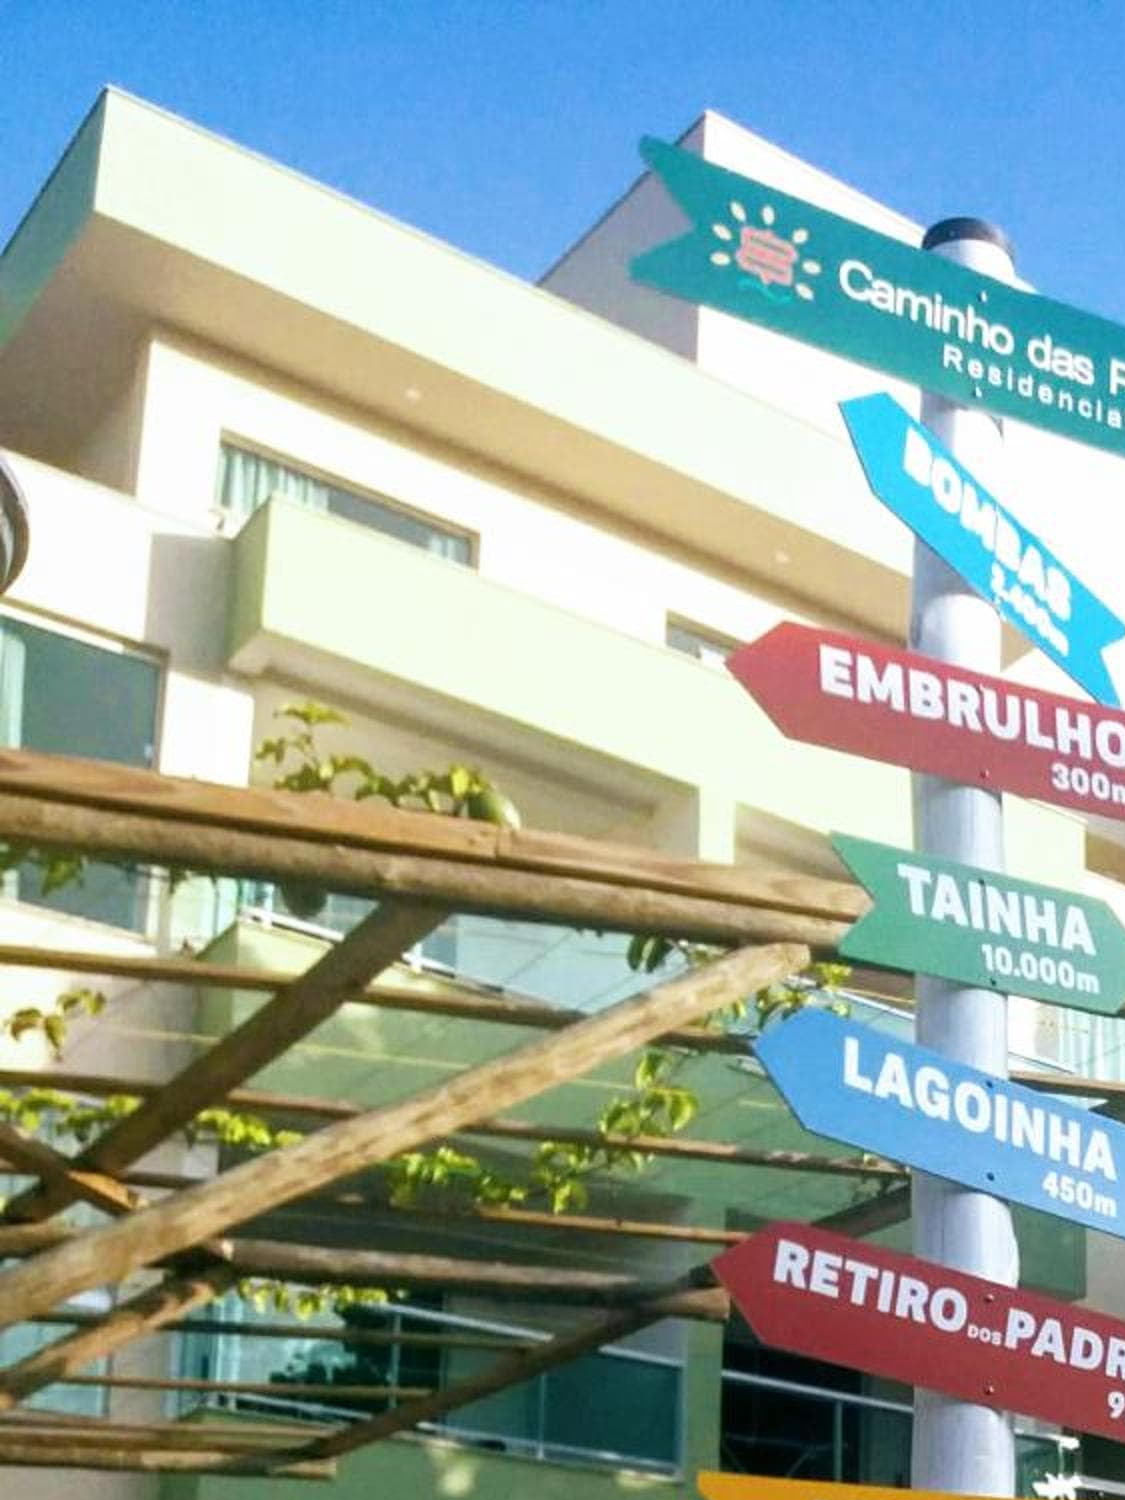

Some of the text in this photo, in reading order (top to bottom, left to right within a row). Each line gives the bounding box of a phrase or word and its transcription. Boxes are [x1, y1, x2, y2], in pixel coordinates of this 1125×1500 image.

[839, 259, 1015, 355] Caminho
[1027, 334, 1095, 385] das
[897, 863, 1097, 955] TAINHA
[981, 944, 1100, 994] 10.000m
[843, 1037, 1118, 1181] LAGOINHA
[1042, 1171, 1118, 1218] 450m
[774, 1240, 968, 1333] RETIRO
[967, 1323, 1002, 1347] DOS
